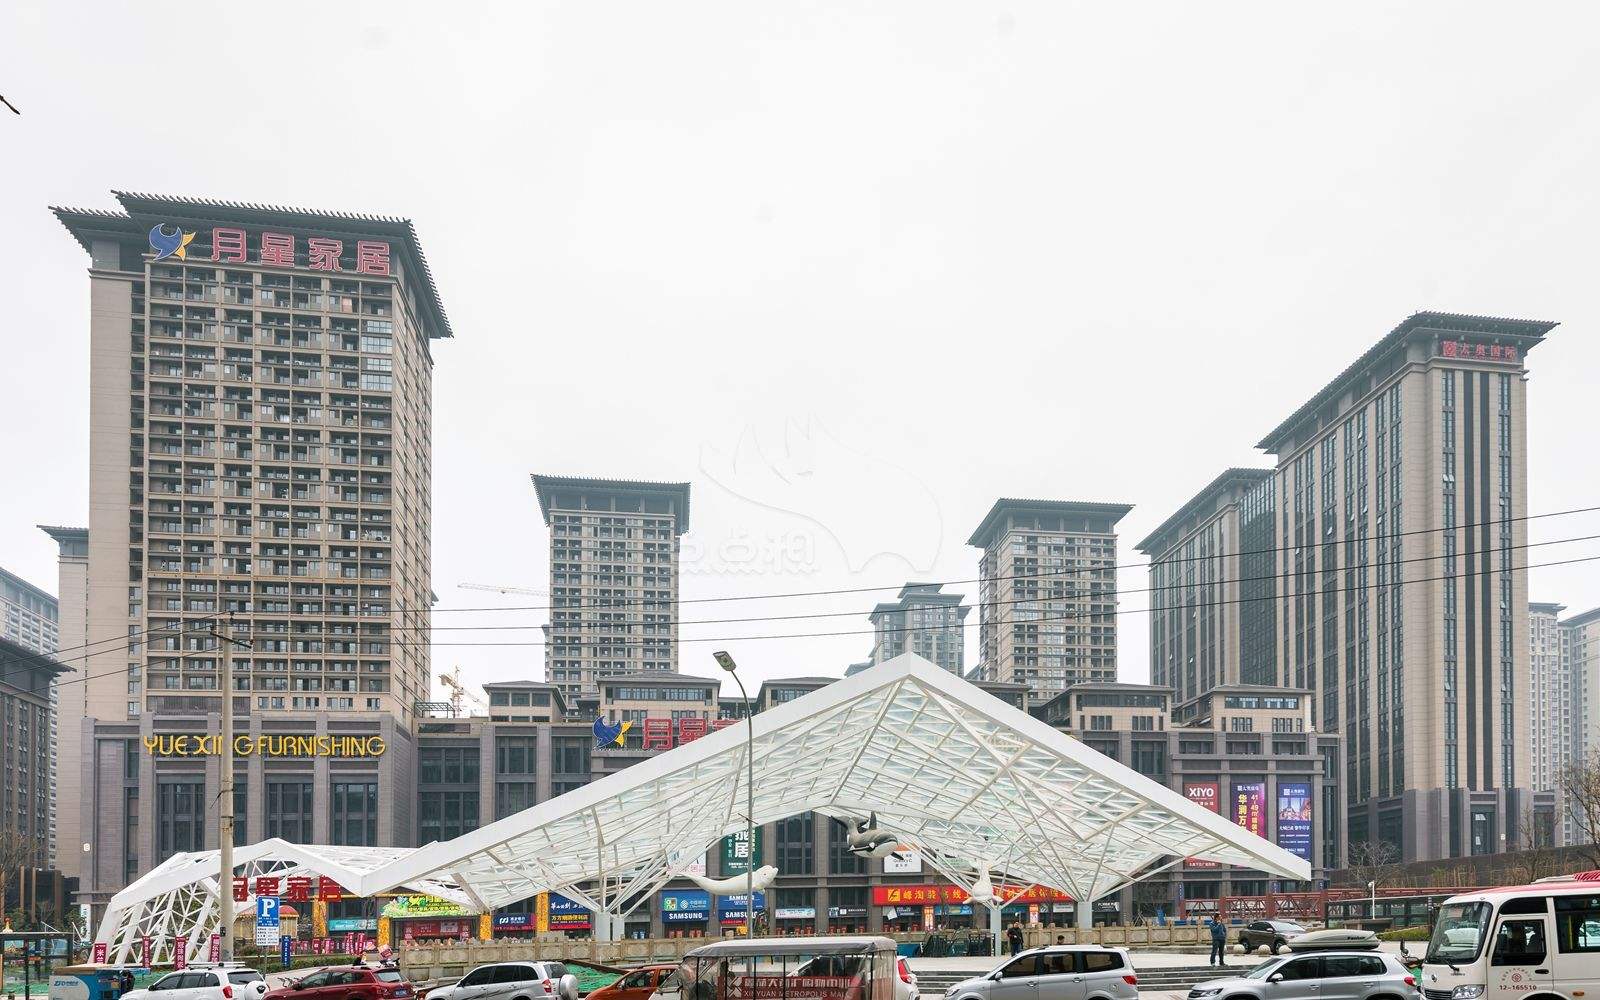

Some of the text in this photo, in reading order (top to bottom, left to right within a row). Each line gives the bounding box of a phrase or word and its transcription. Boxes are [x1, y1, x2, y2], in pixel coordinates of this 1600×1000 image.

[211, 227, 391, 276] 月星家居
[642, 718, 741, 750] 月星
[257, 735, 386, 756] FURNISHING
[1189, 787, 1214, 797] XIYO
[1238, 793, 1248, 829] 华润万
[262, 898, 275, 917] P
[669, 912, 702, 920] SAMSUNG
[779, 990, 828, 998] METROPOLIS
